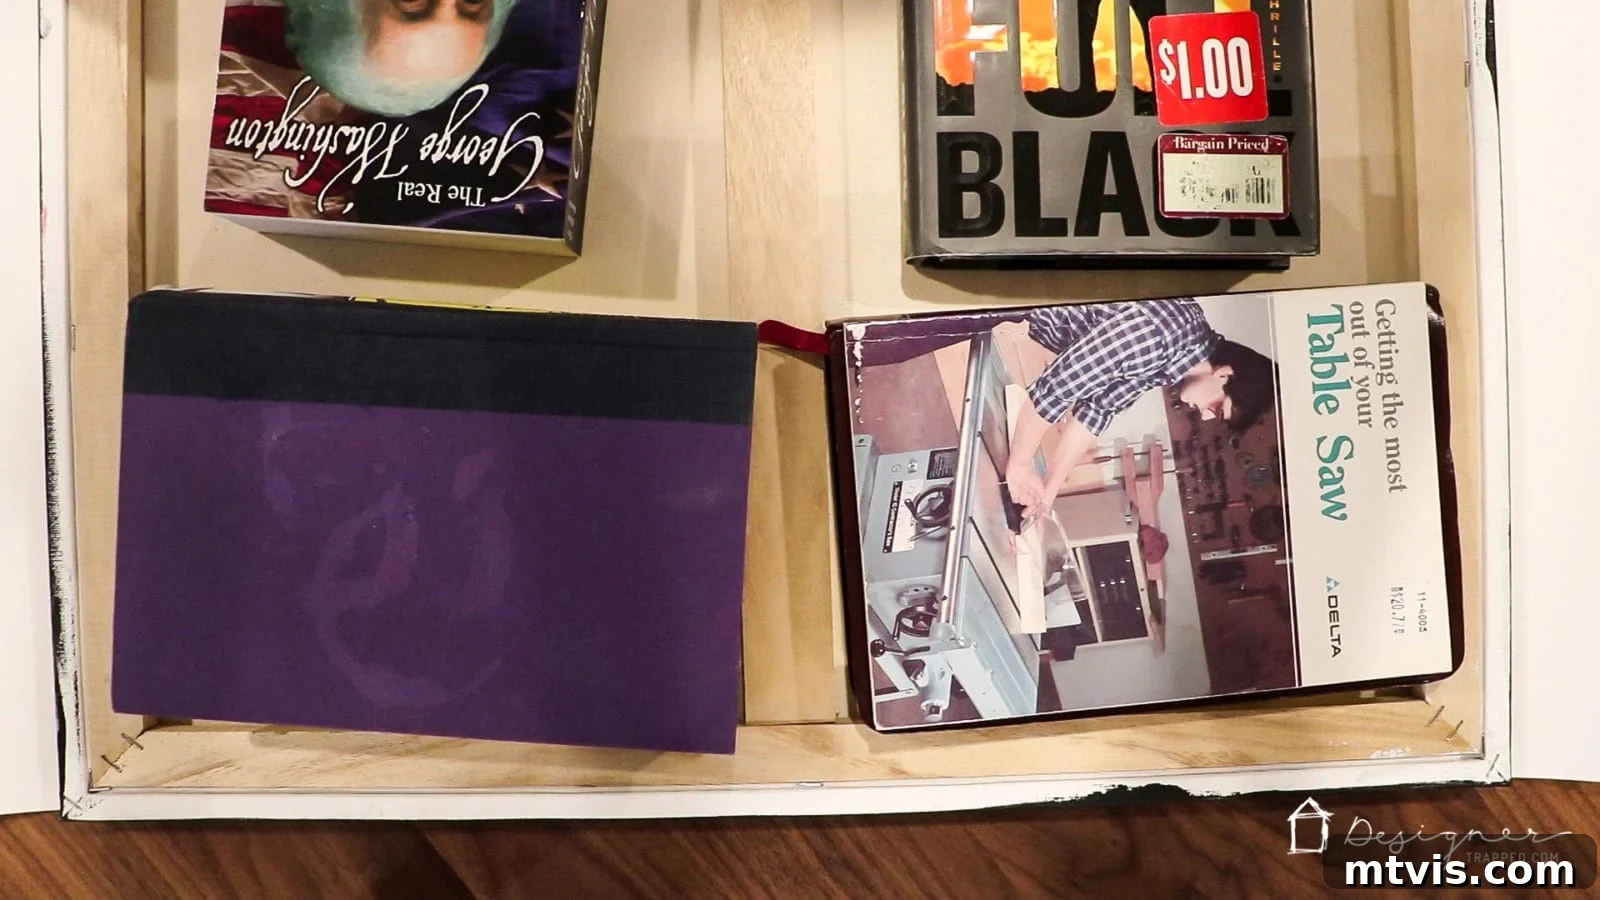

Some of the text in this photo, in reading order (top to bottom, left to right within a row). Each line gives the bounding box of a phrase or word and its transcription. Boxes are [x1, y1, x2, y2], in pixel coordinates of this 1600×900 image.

[1158, 37, 1253, 100] $1.00
[225, 75, 409, 214] Washington
[398, 181, 487, 207] The Real
[419, 83, 544, 203] George
[936, 131, 1301, 239] BLA
[1174, 135, 1270, 152] Bargain Priced
[1306, 303, 1355, 522] Table Saw
[1349, 301, 1375, 428] out of your
[1375, 298, 1408, 493] Getting the most
[1328, 595, 1342, 658] DELTA
